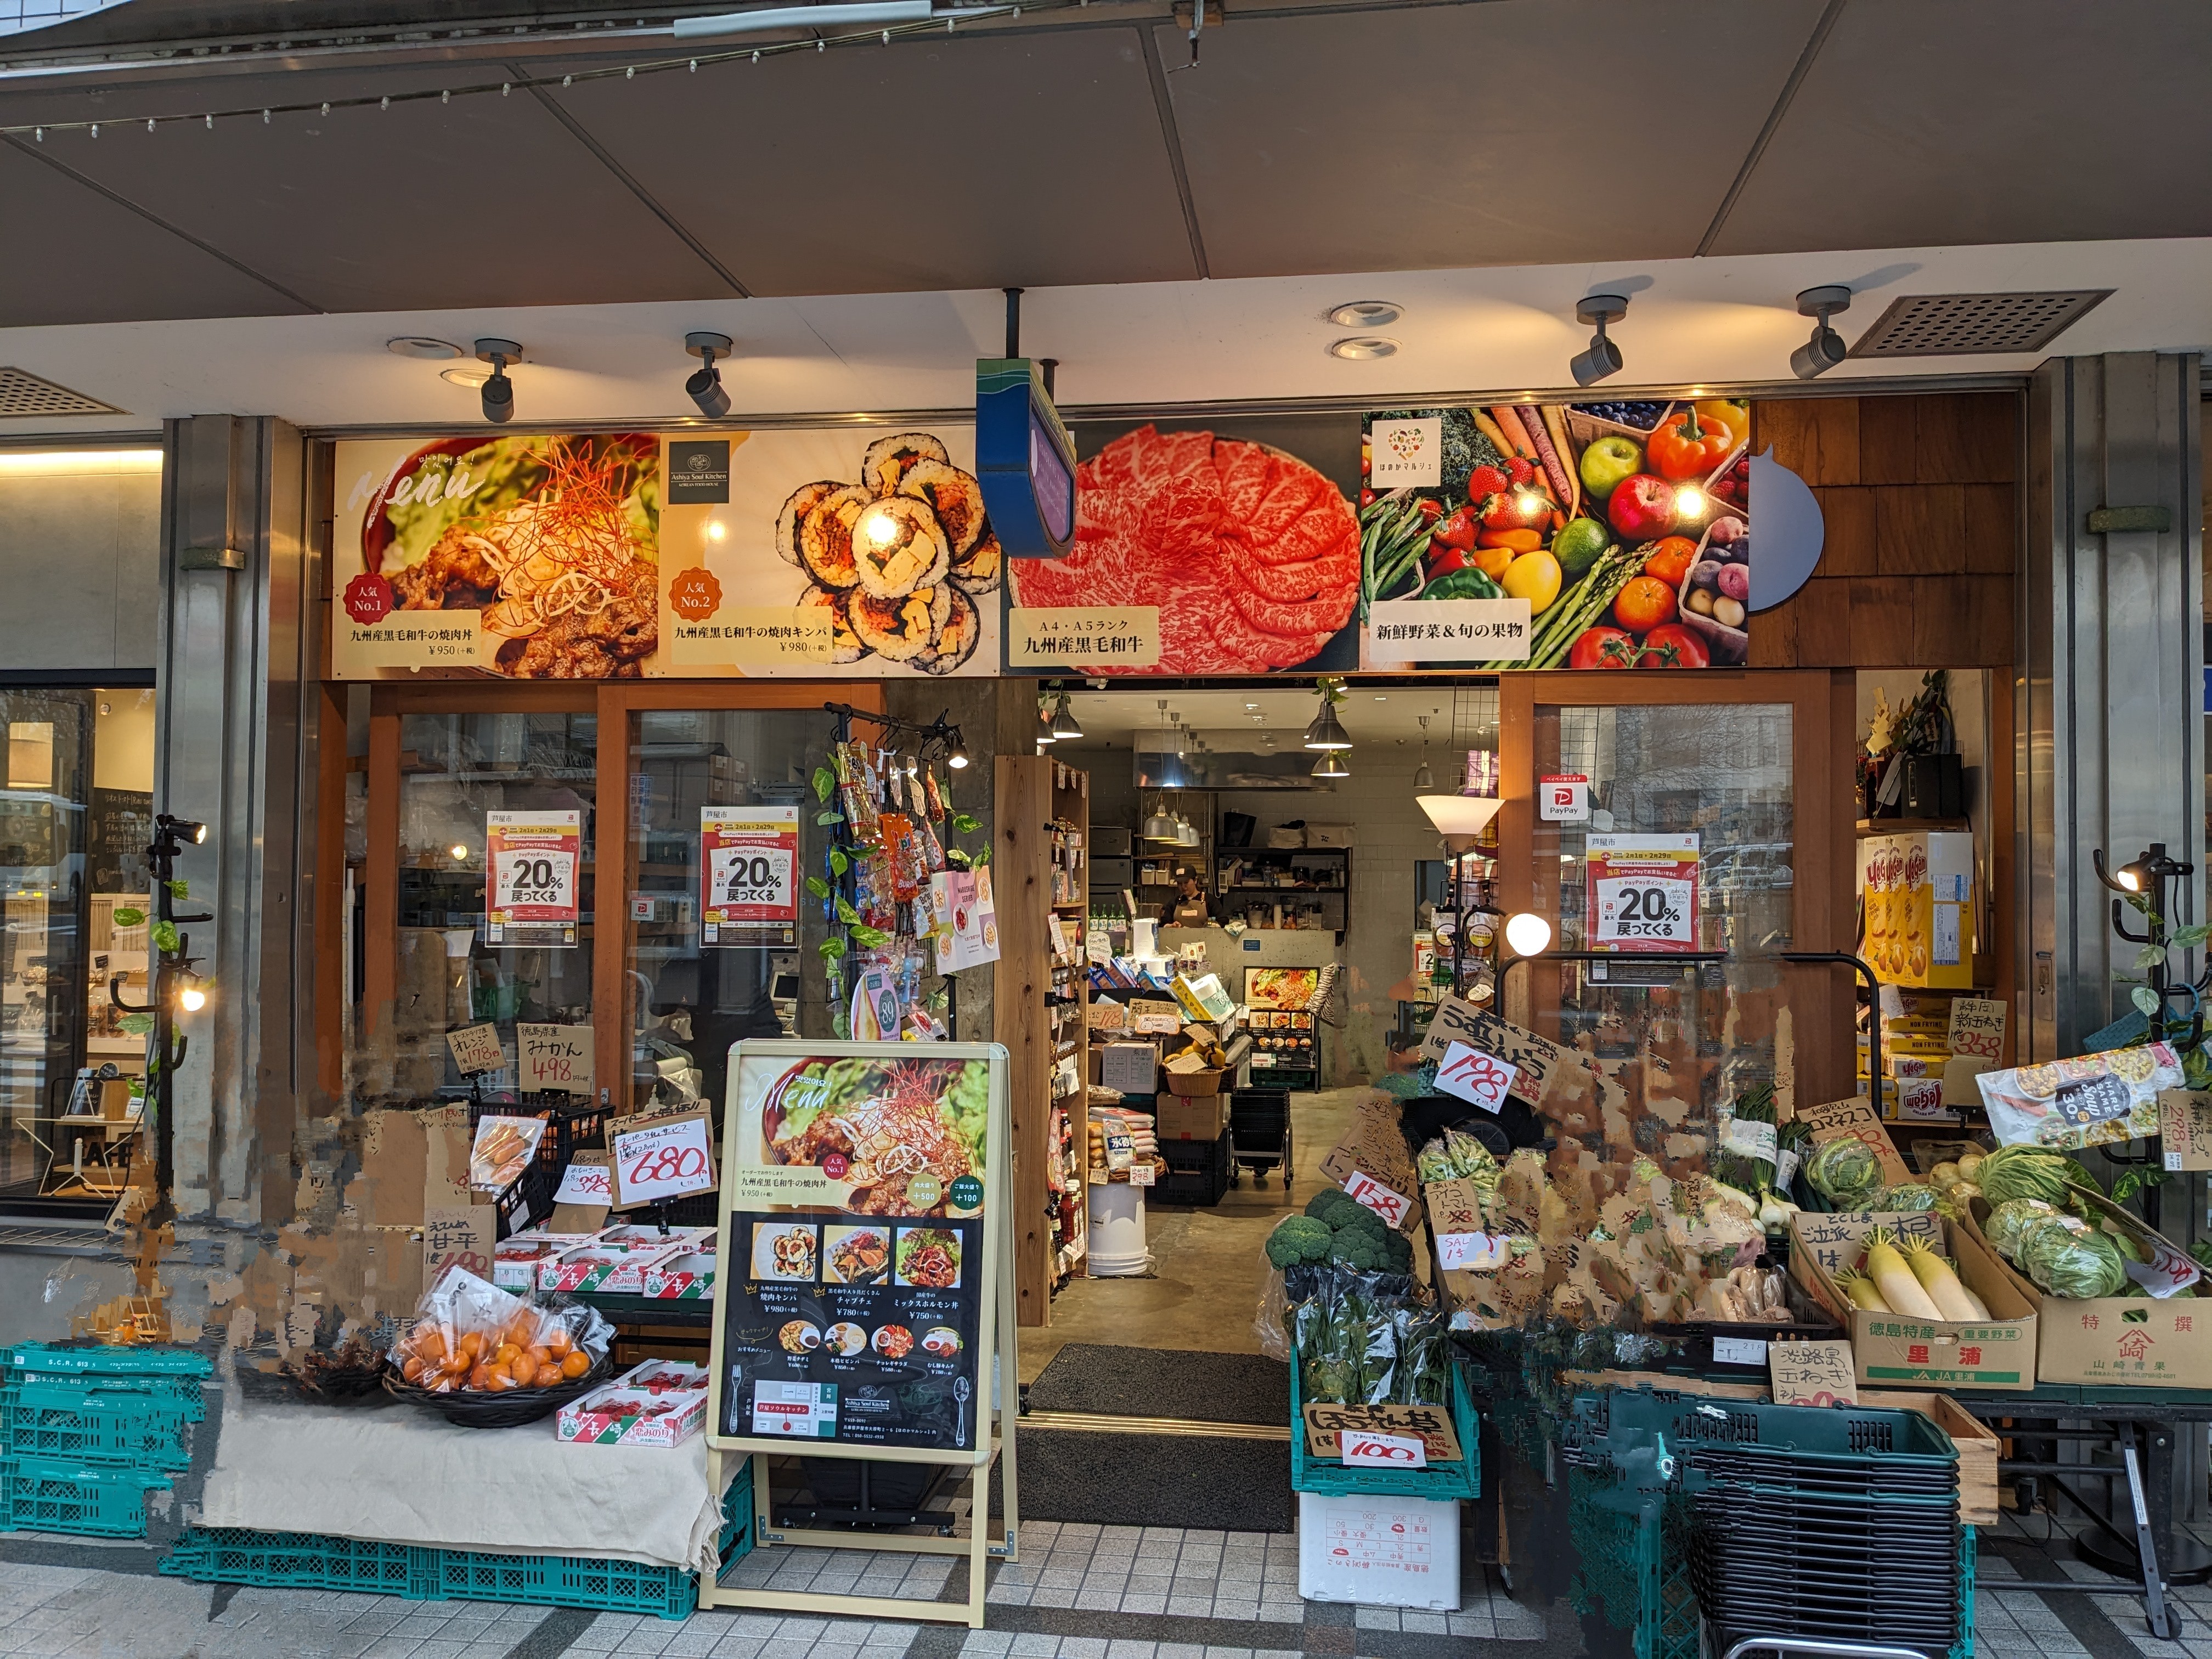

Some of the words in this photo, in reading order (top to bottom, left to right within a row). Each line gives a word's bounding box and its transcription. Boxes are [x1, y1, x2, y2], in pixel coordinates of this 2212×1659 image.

[1380, 463, 1432, 471] ほのかマルシェ
[347, 454, 486, 529] Menu
[358, 587, 377, 597] 人気
[684, 582, 705, 594] 人気
[354, 600, 381, 611] No.1
[680, 596, 710, 608] No.2
[350, 629, 473, 642] 九州産黒毛和牛の焼肉丼
[674, 626, 827, 640] 九州産黒毛和牛の焼肉キンパ
[1023, 636, 1144, 654] 九州産黒毛和牛
[1592, 838, 1615, 846] 芦屋市
[513, 859, 563, 889] 20%
[729, 857, 781, 888] 20%
[511, 890, 557, 902] 戻ってくる
[727, 889, 775, 901] 戻ってくる
[962, 894, 973, 902] SERIES
[1618, 888, 1680, 921] 20%
[1616, 922, 1673, 936] 戻ってくる
[882, 1001, 894, 1024] 89
[1957, 1001, 1994, 1013] 静岡
[1100, 1011, 1122, 1026] 178
[1955, 1011, 2006, 1032] 新玉ねぎ
[521, 1026, 560, 1037] 徳島県産
[454, 1035, 488, 1052] オレンジ
[527, 1040, 583, 1057] みかん
[745, 1073, 830, 1114] Menu
[2096, 1083, 2112, 1113] SAME
[2104, 1081, 2121, 1112] HARU
[2081, 1084, 2101, 1116] Soup
[1808, 1108, 1872, 1133] ロマネスコ
[827, 1165, 844, 1173] No.1
[741, 1177, 827, 1188] 九州産黒毛和牛の焼肉丼
[1132, 1173, 1149, 1181] 398
[1433, 1181, 1460, 1189] あいち
[1429, 1189, 1464, 1200] アイコ
[1441, 1198, 1474, 1209] トマト
[1826, 1212, 1873, 1224] とくしま
[428, 1233, 479, 1250] 甘平
[567, 1272, 601, 1286] 長崎
[611, 1275, 644, 1284] 恋みのり
[672, 1278, 707, 1292] 長崎
[760, 1293, 797, 1301] 焼肉キンパ
[837, 1296, 872, 1305] チャプチェ
[1869, 1322, 1936, 1339] 徳島特産
[1963, 1329, 2017, 1339] 重要野菜
[1743, 1342, 1762, 1351] 218
[1781, 1347, 1846, 1368] 淡路島
[1778, 1368, 1852, 1389] 玉ねぎ
[759, 1404, 807, 1413] 芦屋ソウルキッチン
[588, 1421, 623, 1438] 長崎
[635, 1427, 669, 1438] 恋みのり
[1403, 1563, 1429, 1573] 徳島産
